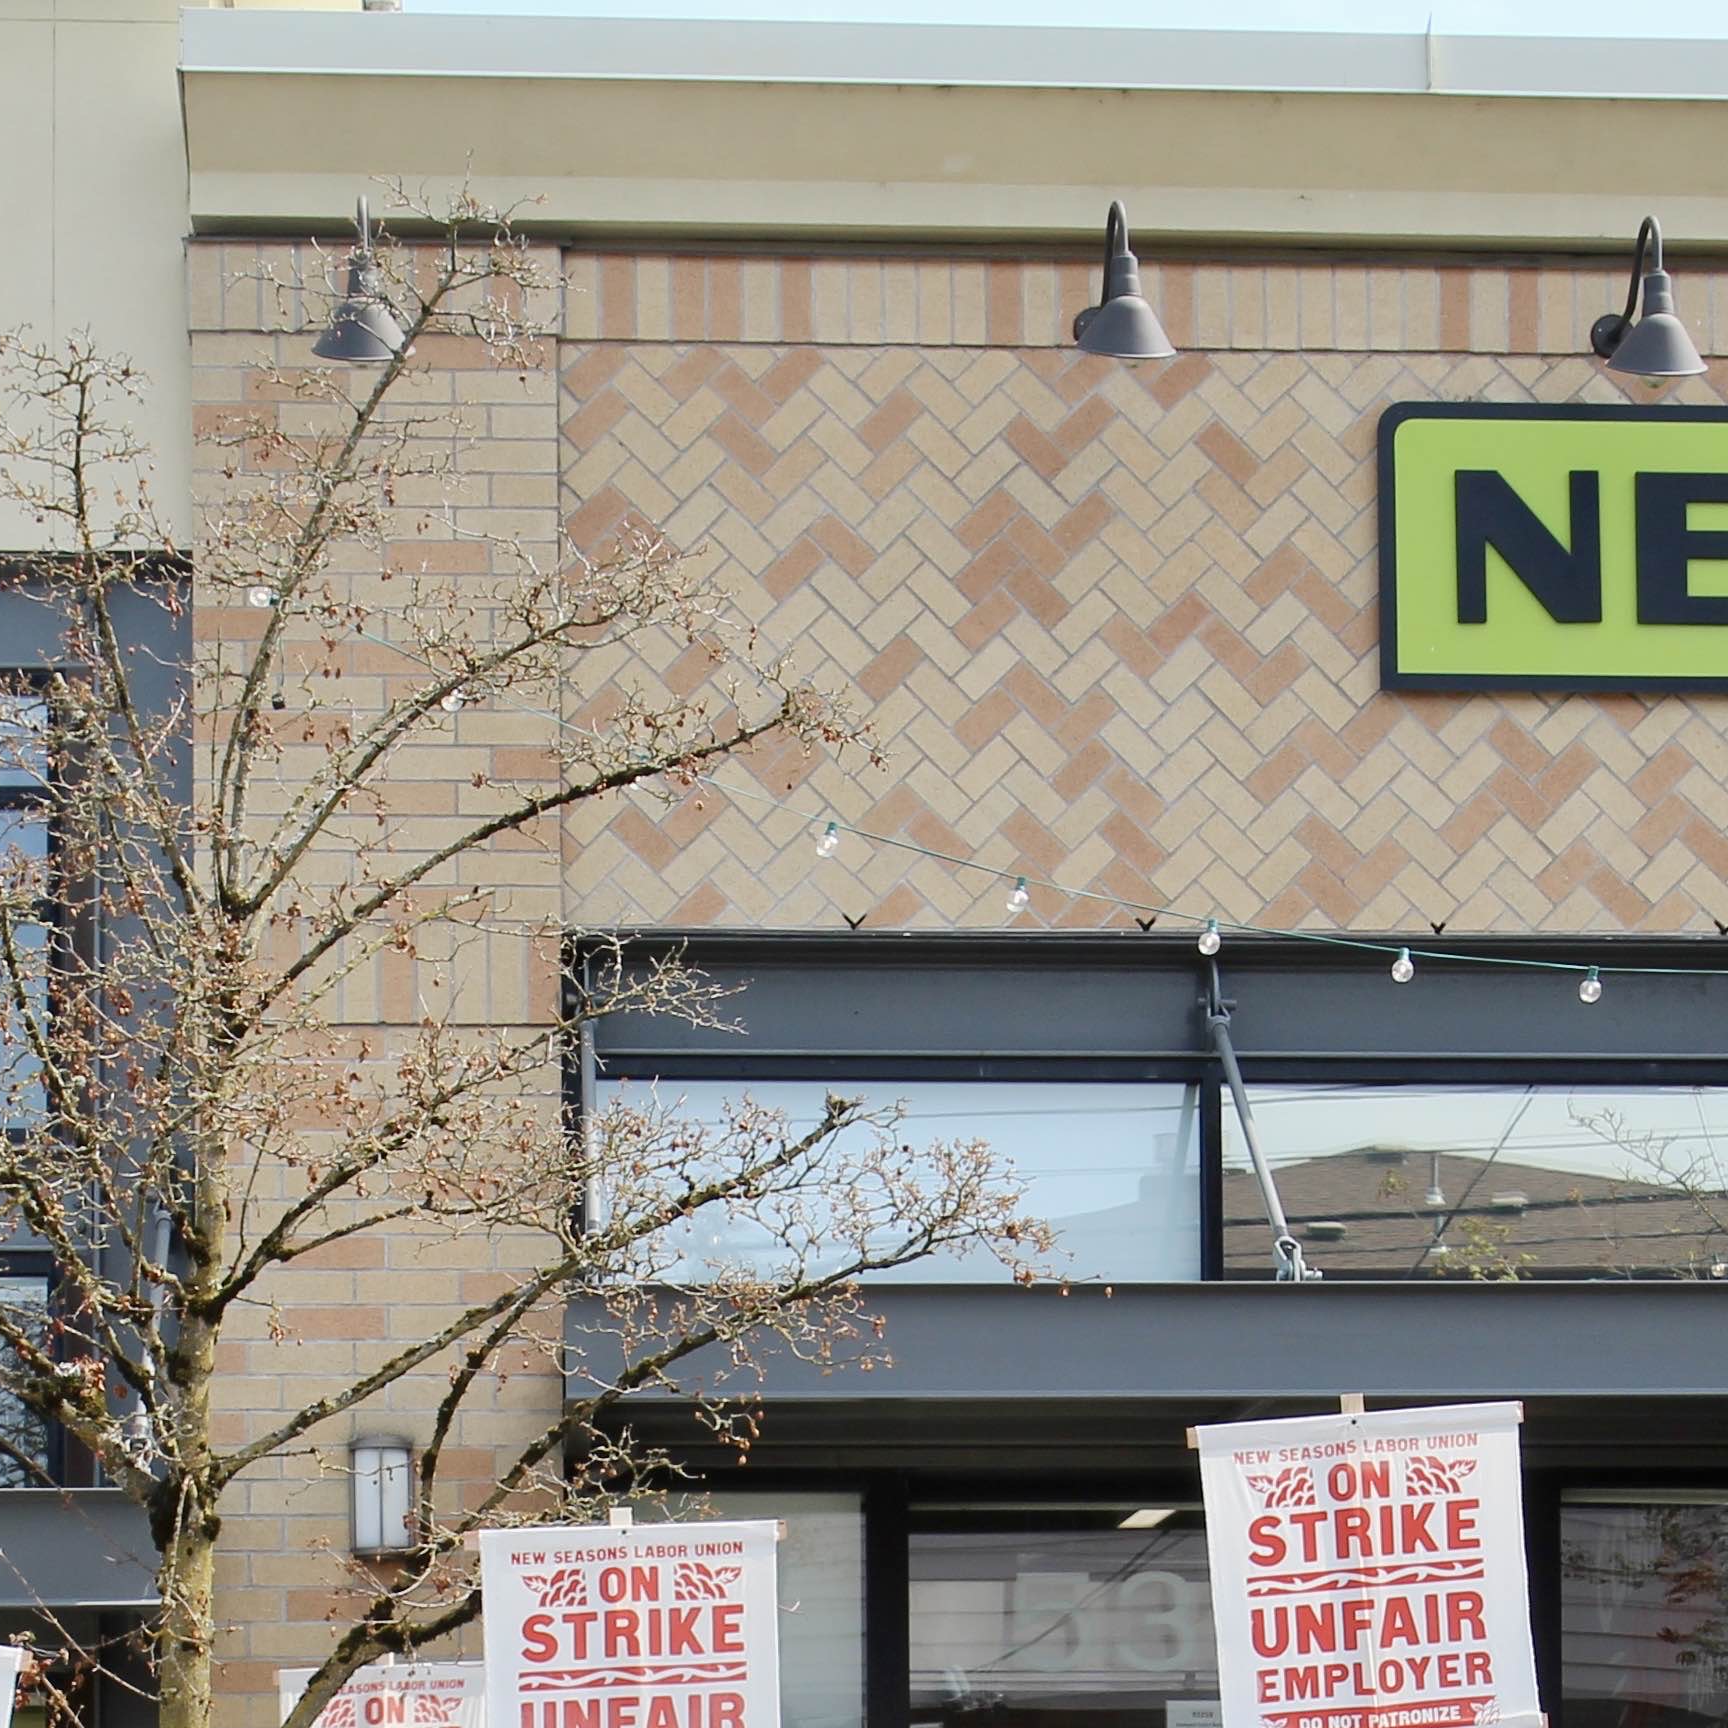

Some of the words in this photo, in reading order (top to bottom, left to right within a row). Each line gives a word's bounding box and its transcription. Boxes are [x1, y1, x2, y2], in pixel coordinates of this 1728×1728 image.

[1233, 1450, 1270, 1464] NEW
[1280, 1441, 1358, 1463] SEASONS
[1362, 1438, 1420, 1454] LABOR
[1427, 1432, 1478, 1450] UNION
[1328, 1463, 1390, 1502] ON
[1248, 1499, 1480, 1567] STRIKE
[512, 1553, 545, 1564] NEW
[555, 1548, 628, 1564] SEASONS
[636, 1545, 688, 1558] LABOR
[695, 1542, 744, 1557] UNION
[600, 1567, 658, 1603] ON
[523, 1604, 743, 1663] STRIKE
[1252, 1592, 1485, 1658] UNFAIR
[335, 1682, 384, 1696] EASONS
[389, 1681, 427, 1693] LABOR
[431, 1680, 465, 1690] UNION
[1258, 1652, 1491, 1703] EMPLOYER
[364, 1696, 405, 1725] ON
[1368, 1705, 1461, 1728] PATRONIZE
